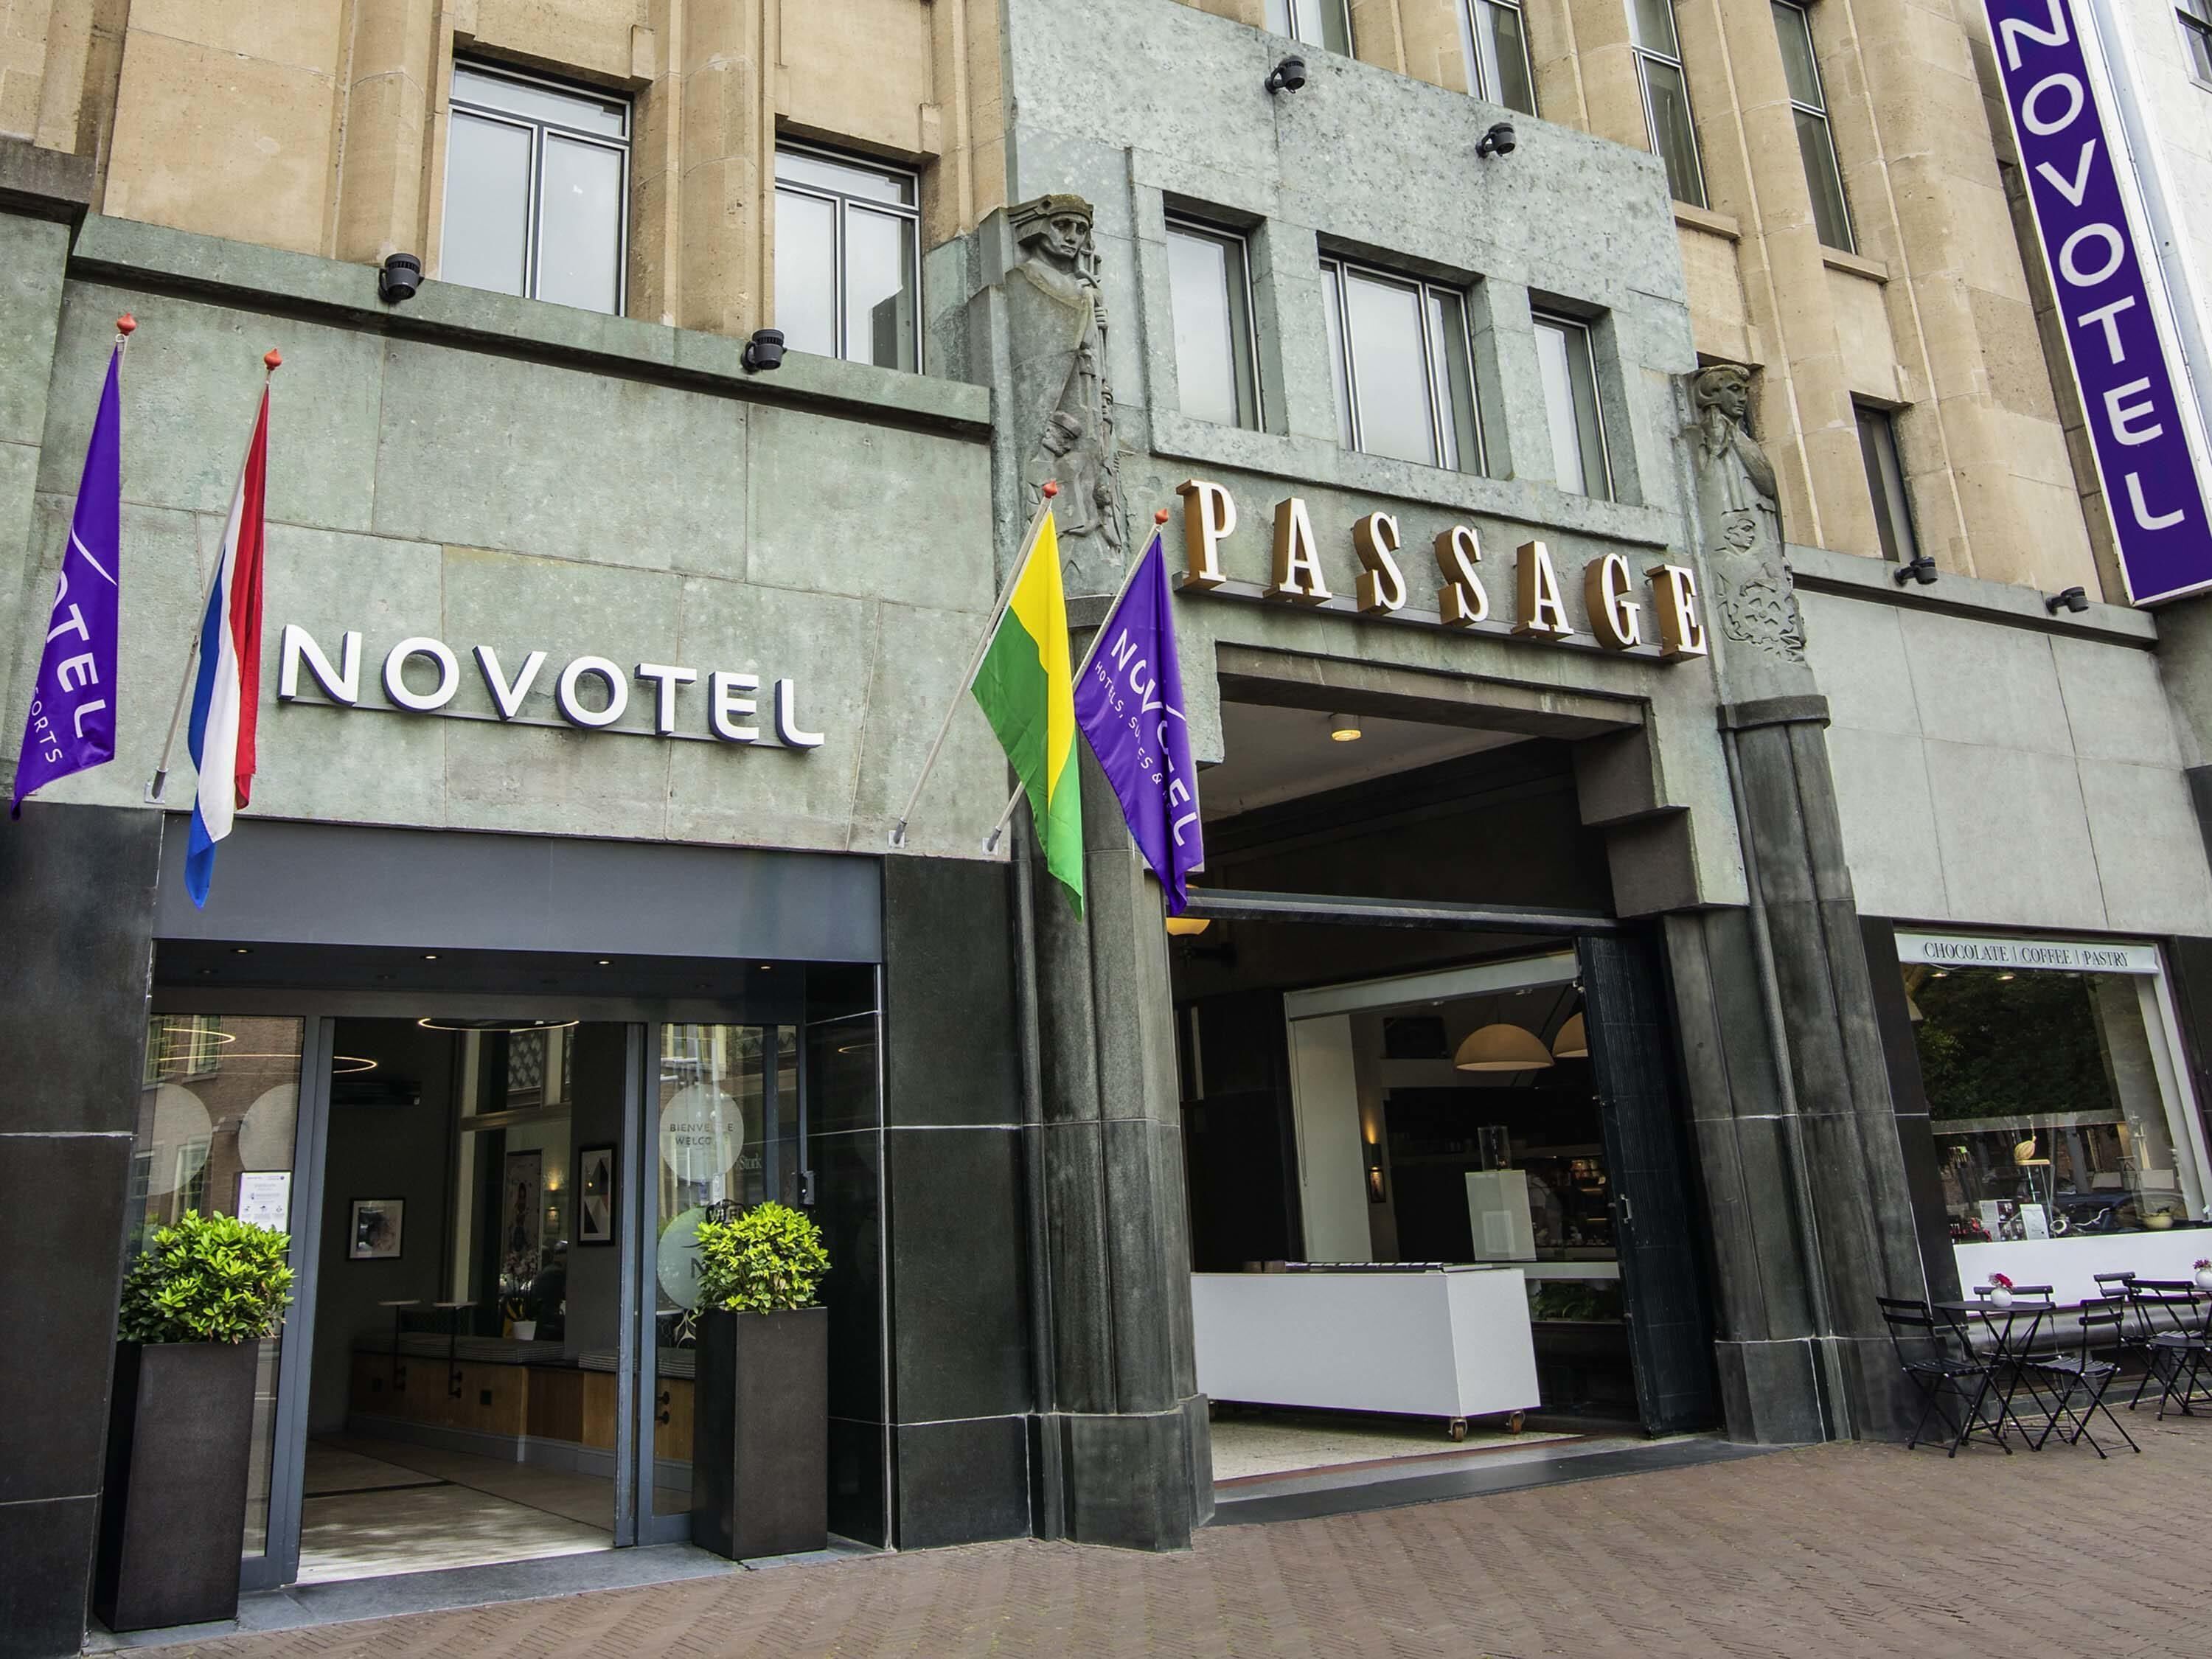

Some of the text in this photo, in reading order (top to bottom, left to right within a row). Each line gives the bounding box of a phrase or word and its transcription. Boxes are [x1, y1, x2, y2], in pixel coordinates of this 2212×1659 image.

[1999, 0, 2185, 531] NOVOTEL
[1176, 479, 1707, 662] PASSAGE
[31, 686, 63, 763] ORTS
[277, 624, 824, 749] NOVOTEL
[1924, 942, 2009, 962] CHOCOLATE
[2021, 947, 2072, 964] COFFEE
[2083, 950, 2129, 967] PASTRY
